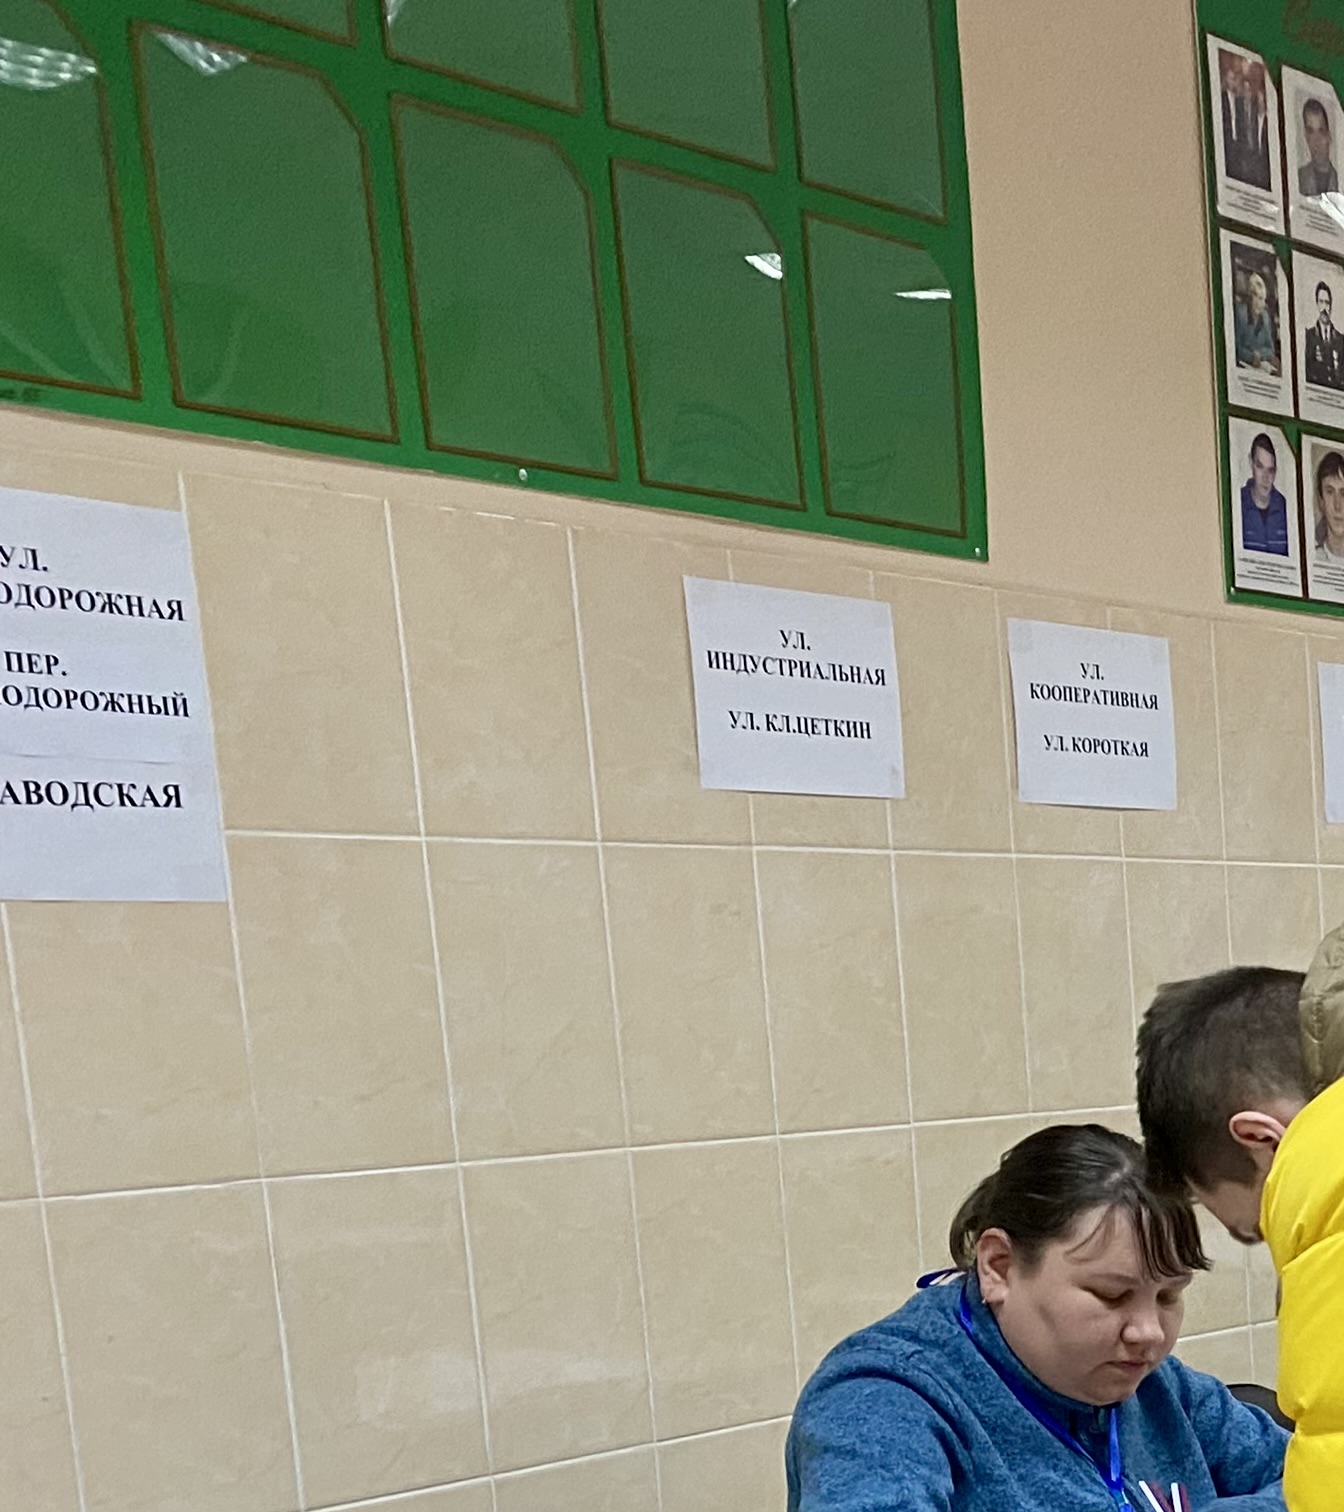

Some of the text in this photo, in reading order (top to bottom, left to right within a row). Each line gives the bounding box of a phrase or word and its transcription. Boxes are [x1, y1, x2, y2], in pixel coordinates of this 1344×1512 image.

[0, 545, 48, 572] УЛ.
[779, 629, 811, 651] УЛ.
[4, 650, 67, 677] ПЕР.
[706, 649, 886, 686] ИНДУСТРИАЛЬНАЯ
[1080, 662, 1105, 680] УЛ.
[1030, 682, 1159, 710] КООПЕРАТИВНАЯ
[728, 710, 872, 740] УЛ. КЛ.ЦЕТКИН
[1043, 734, 1149, 758] УЛ. КОРОТКАЯ
